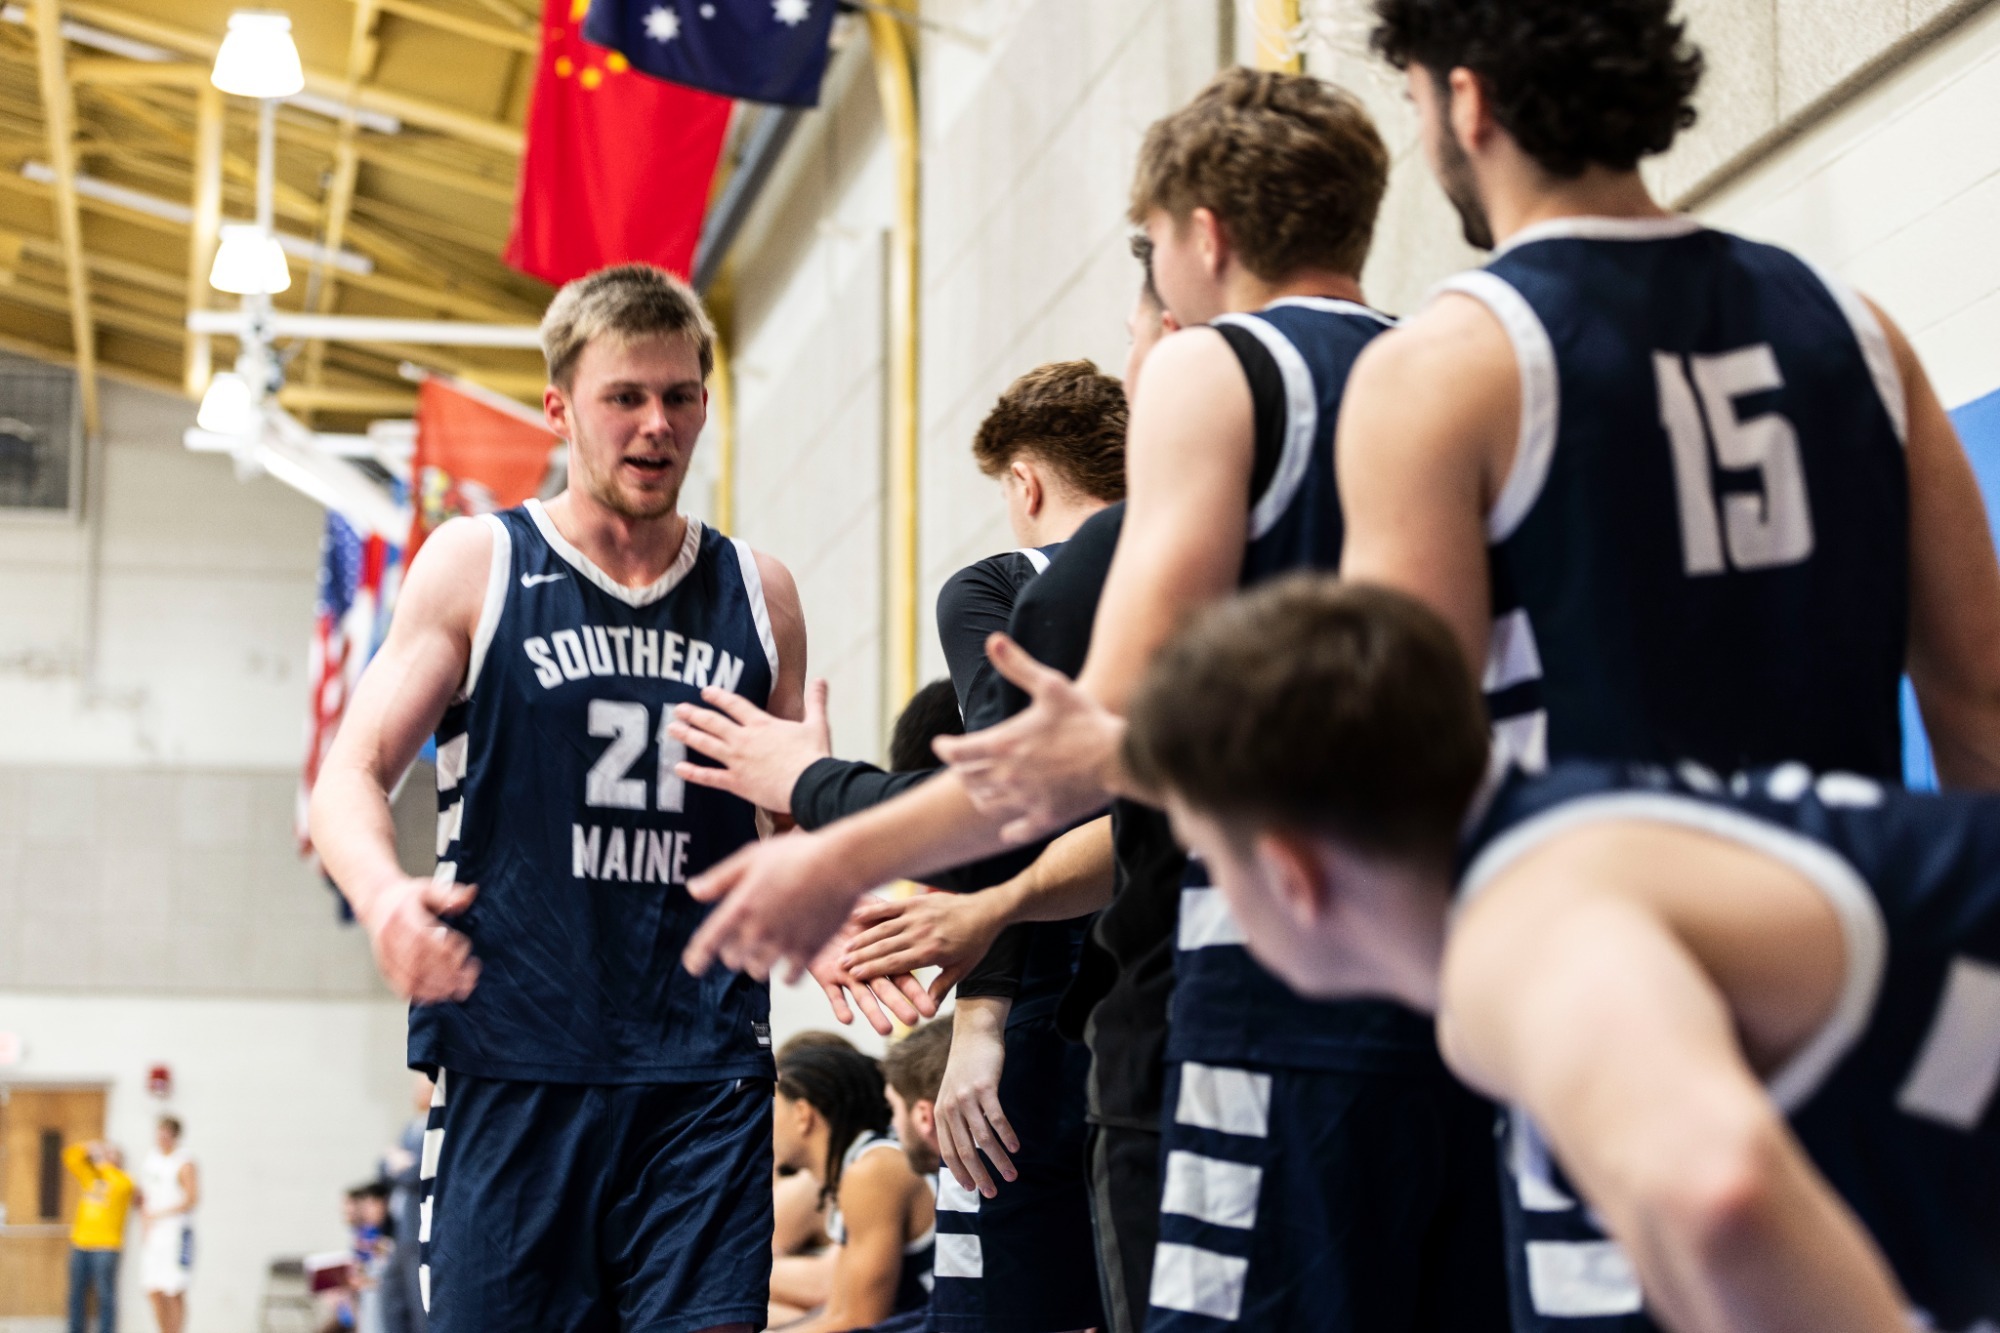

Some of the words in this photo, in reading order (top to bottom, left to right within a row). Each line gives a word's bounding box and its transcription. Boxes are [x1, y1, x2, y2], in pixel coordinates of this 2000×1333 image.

[1652, 342, 1815, 577] 15
[523, 625, 744, 692] SOUTHERN
[585, 698, 688, 813] 21
[572, 822, 691, 885] MAINE
